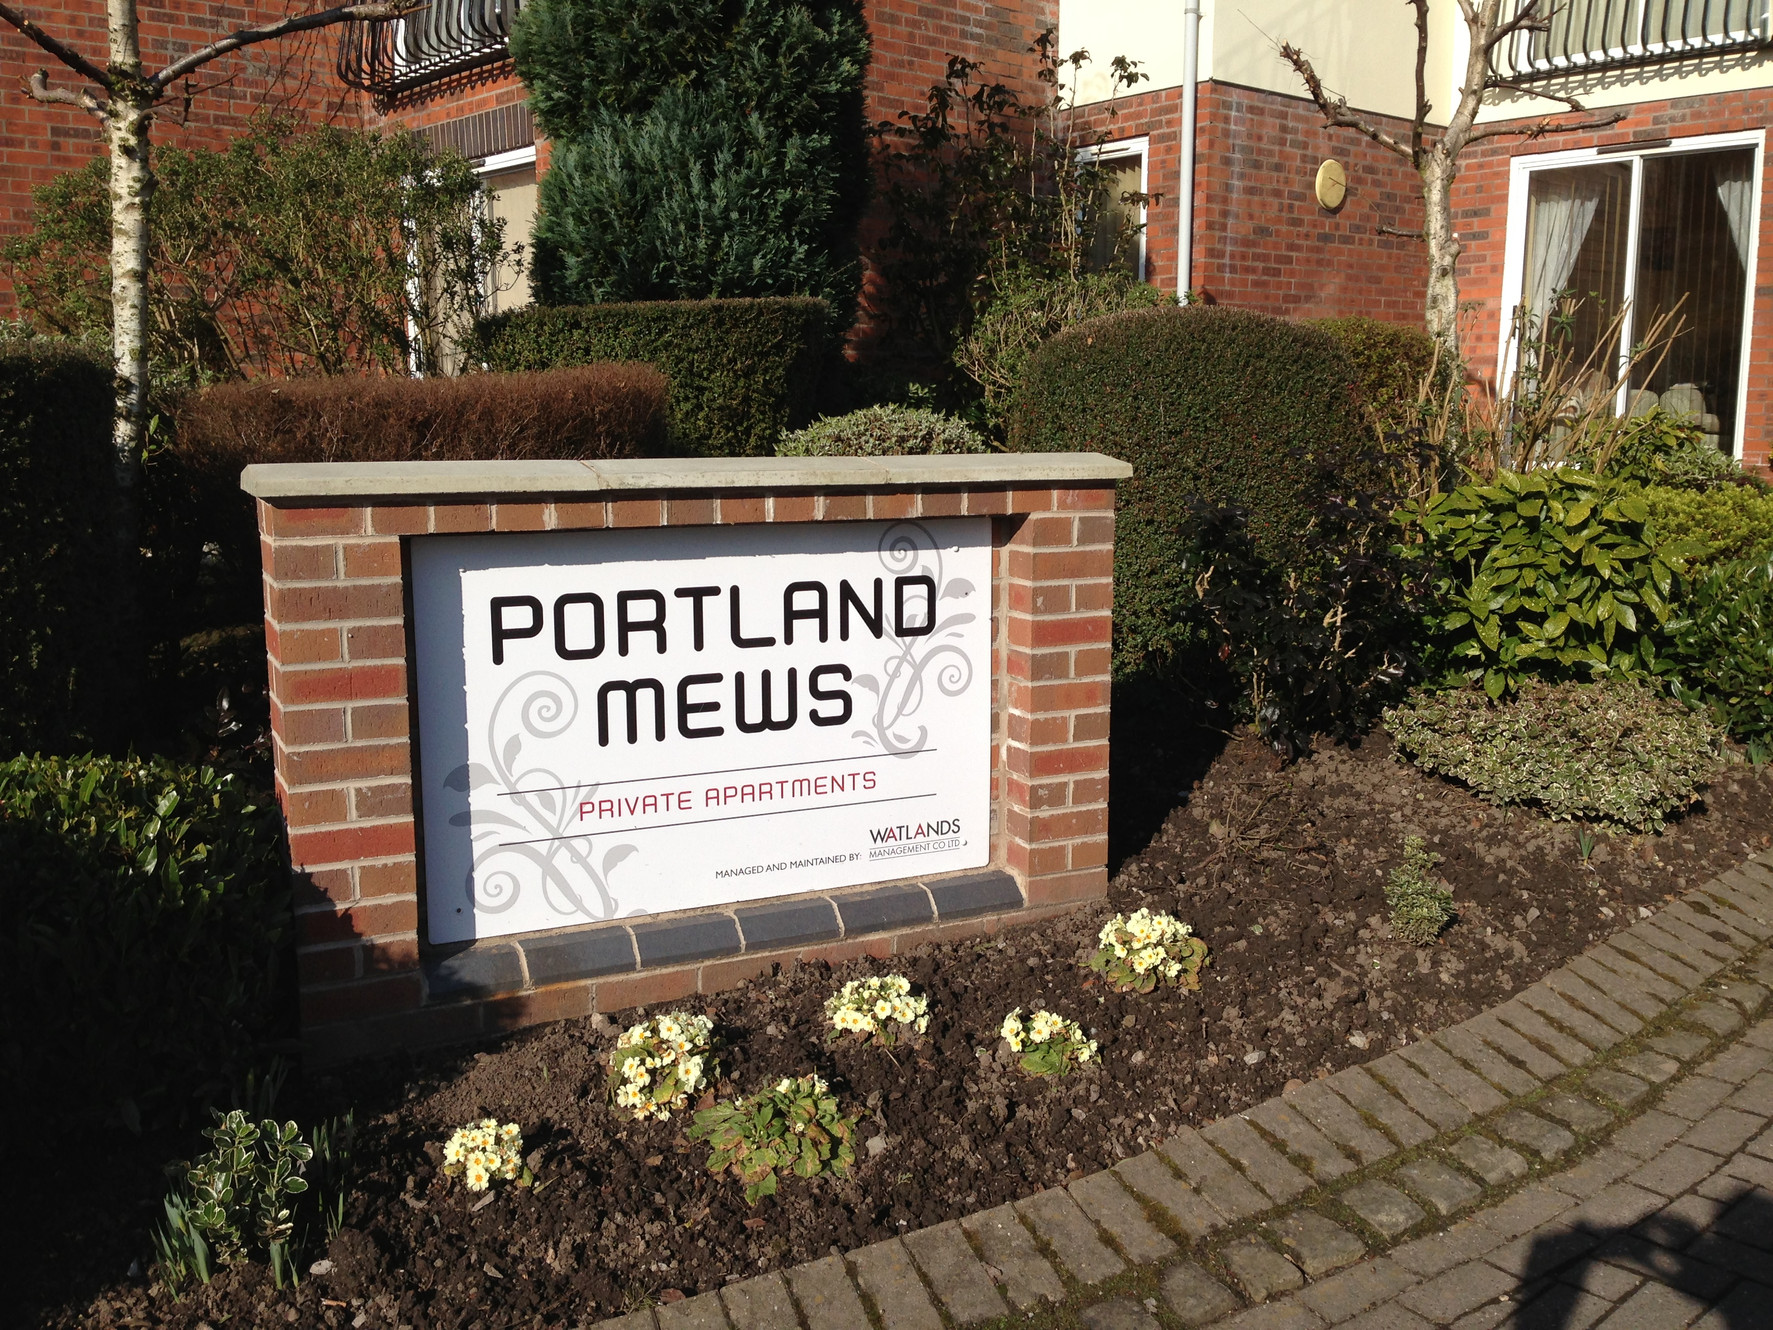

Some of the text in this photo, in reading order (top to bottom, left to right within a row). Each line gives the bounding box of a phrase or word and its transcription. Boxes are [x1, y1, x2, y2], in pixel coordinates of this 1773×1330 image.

[490, 575, 937, 666] PORTLAND
[597, 663, 854, 748] MEWS
[579, 771, 878, 822] PRIVATE APARTMENTS
[869, 818, 961, 845] WATLANDS
[869, 838, 960, 859] MANAGEMENT CO LTD
[715, 852, 862, 879] MANAGED AND MAINTAINED BY:
